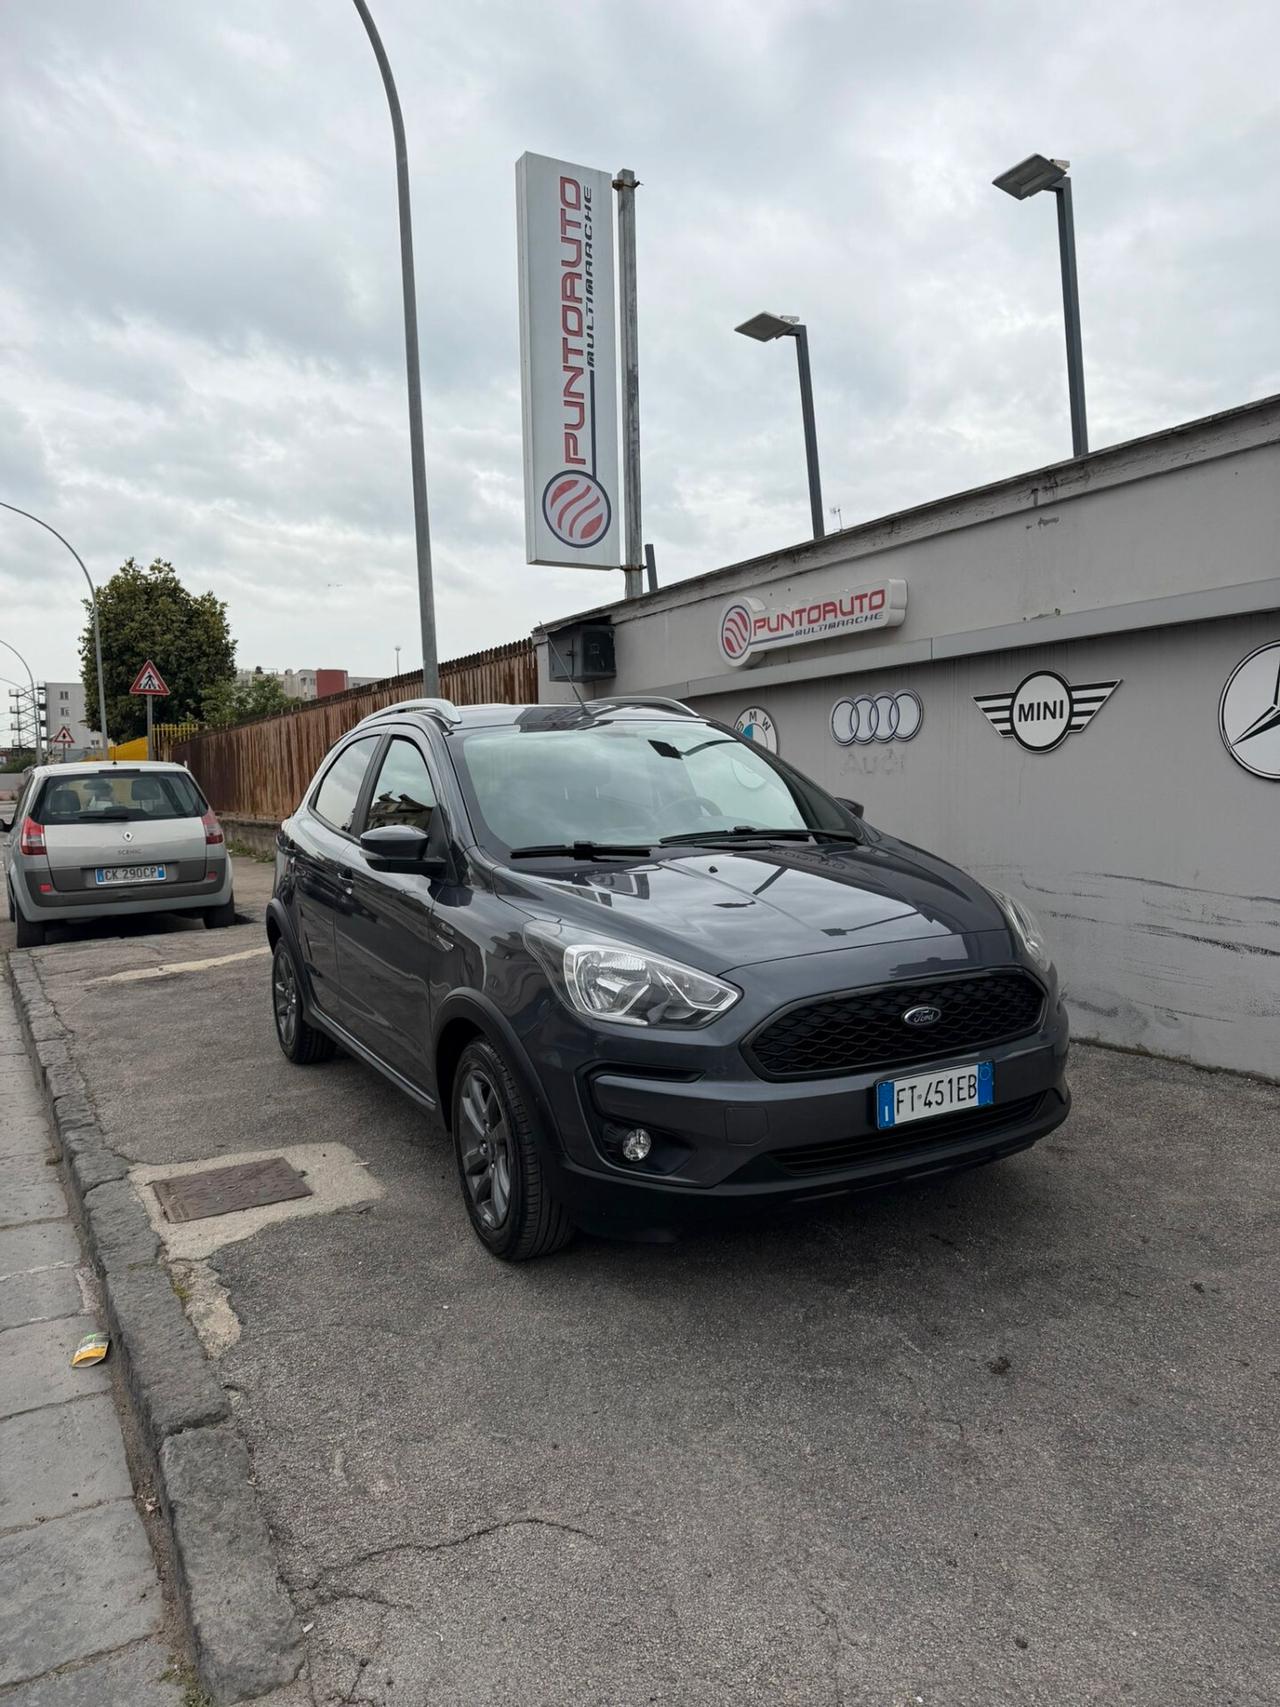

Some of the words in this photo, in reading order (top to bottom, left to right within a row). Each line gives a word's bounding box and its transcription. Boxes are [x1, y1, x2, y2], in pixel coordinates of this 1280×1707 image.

[584, 186, 595, 368] MULTIMARCHE
[560, 175, 586, 466] PUNTOAUTO
[753, 588, 886, 636] PUNTOAUTO
[794, 612, 884, 636] MULTIMARCHE
[736, 710, 771, 732] BMW
[1018, 699, 1064, 722] MINI
[105, 869, 118, 880] CK
[122, 866, 157, 879] 290CP
[896, 1085, 918, 1115] FT
[924, 1073, 978, 1108] 451EB
